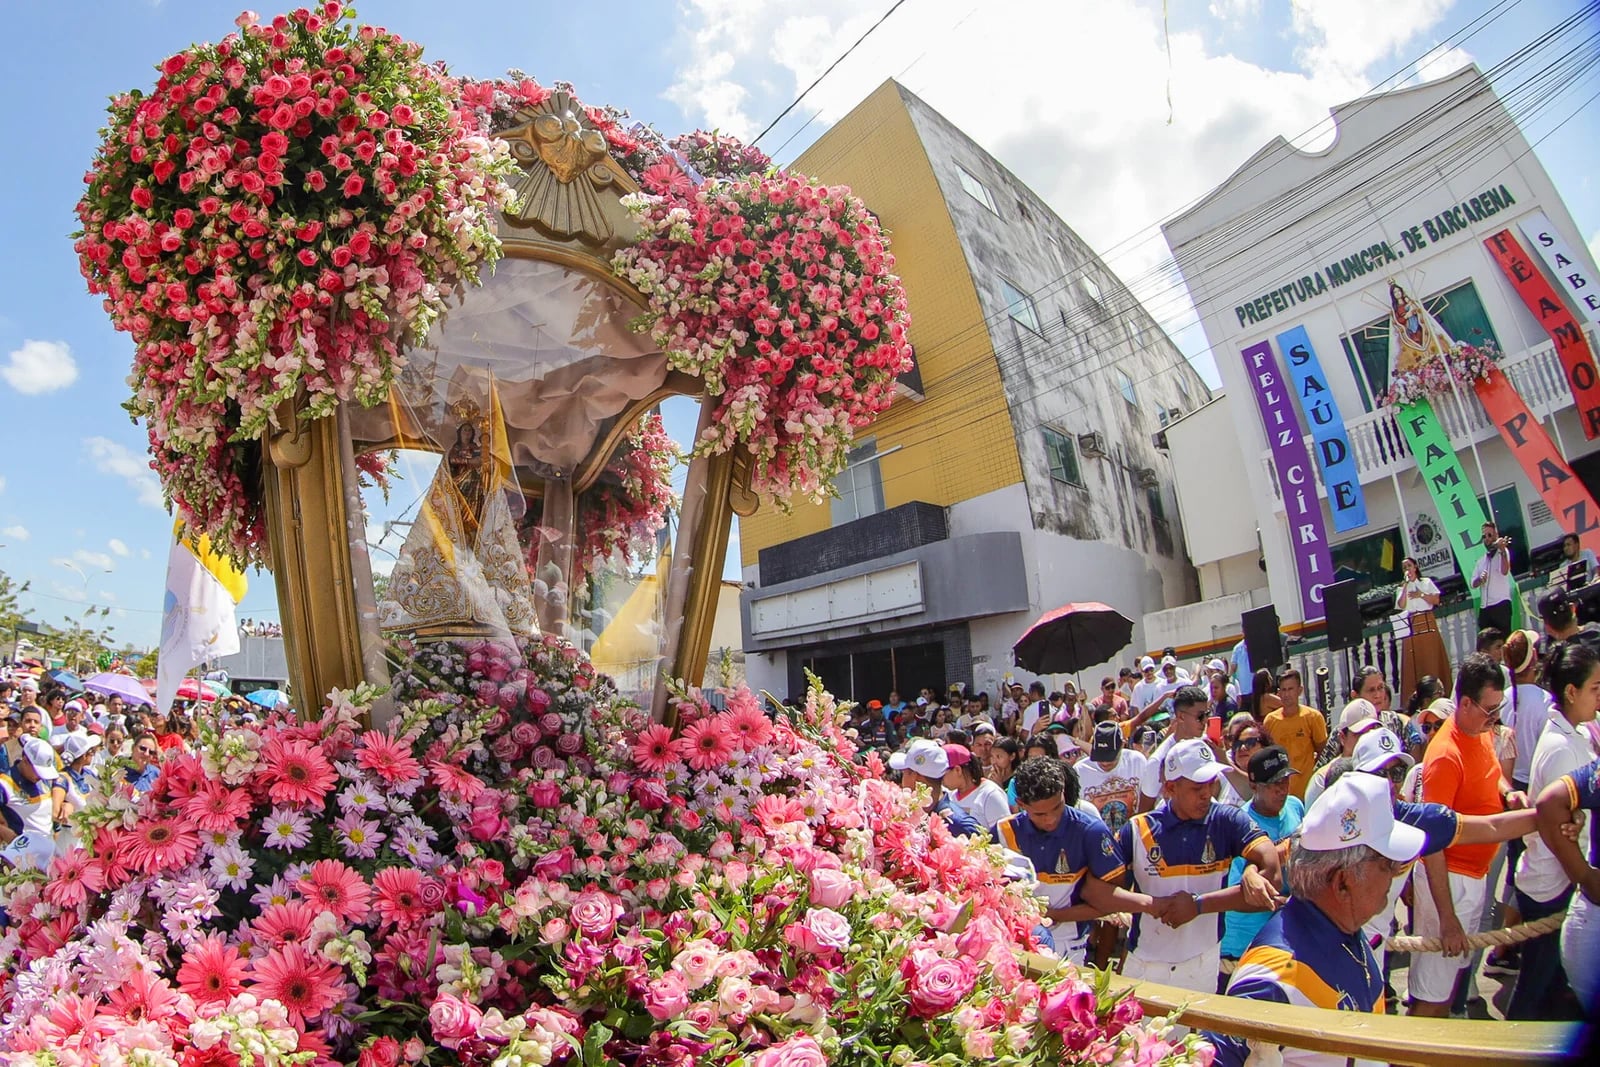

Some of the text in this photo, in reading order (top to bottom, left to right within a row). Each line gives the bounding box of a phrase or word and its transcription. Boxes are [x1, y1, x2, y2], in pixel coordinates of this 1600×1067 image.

[1234, 271, 1328, 328] PREFEITURA
[1400, 225, 1427, 254] DE
[1422, 184, 1516, 243] BARCARENA
[1491, 229, 1532, 283] FÉ
[1538, 231, 1600, 312] SABE
[1252, 351, 1324, 604] FELIZ CÍRIO
[1289, 343, 1357, 511] SAÚDE
[1409, 414, 1484, 550] FAMÍL
[1502, 412, 1600, 535] PAZ
